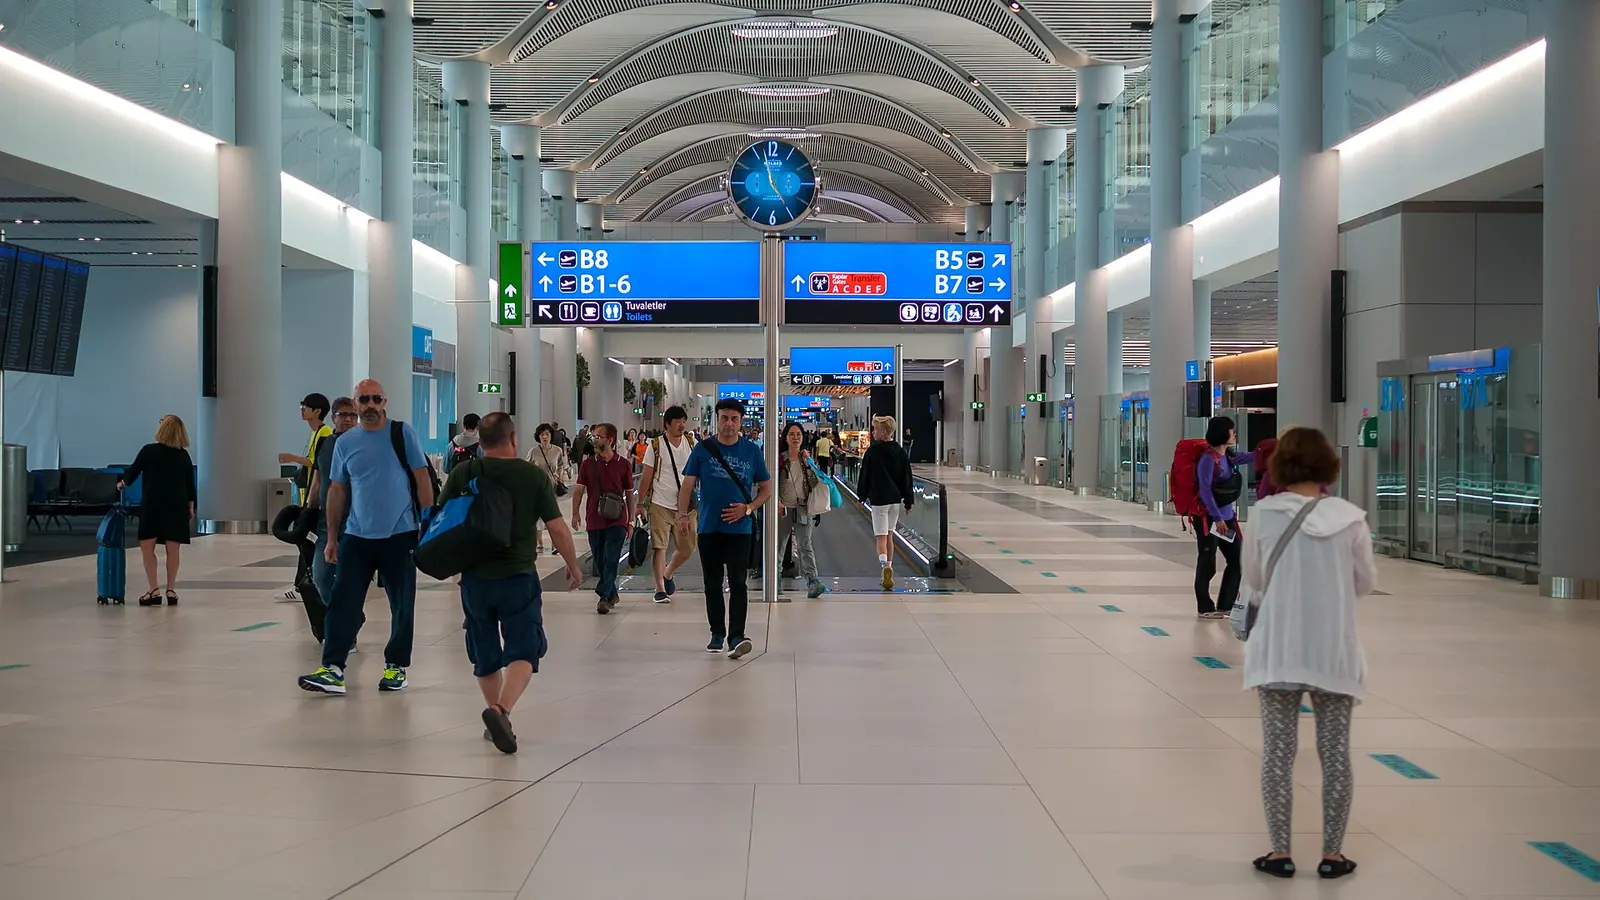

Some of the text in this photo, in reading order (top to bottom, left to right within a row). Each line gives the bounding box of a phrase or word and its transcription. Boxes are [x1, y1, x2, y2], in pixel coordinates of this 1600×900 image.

[768, 141, 778, 157] 12
[769, 209, 777, 225] 6
[580, 249, 609, 269] B8
[936, 250, 963, 269] B5
[580, 275, 631, 294] B1-6
[850, 274, 880, 282] Transfer
[936, 275, 963, 294] B7
[832, 285, 882, 293] A C D E F
[625, 301, 667, 310] Tuvaletler
[625, 312, 653, 321] Toilets
